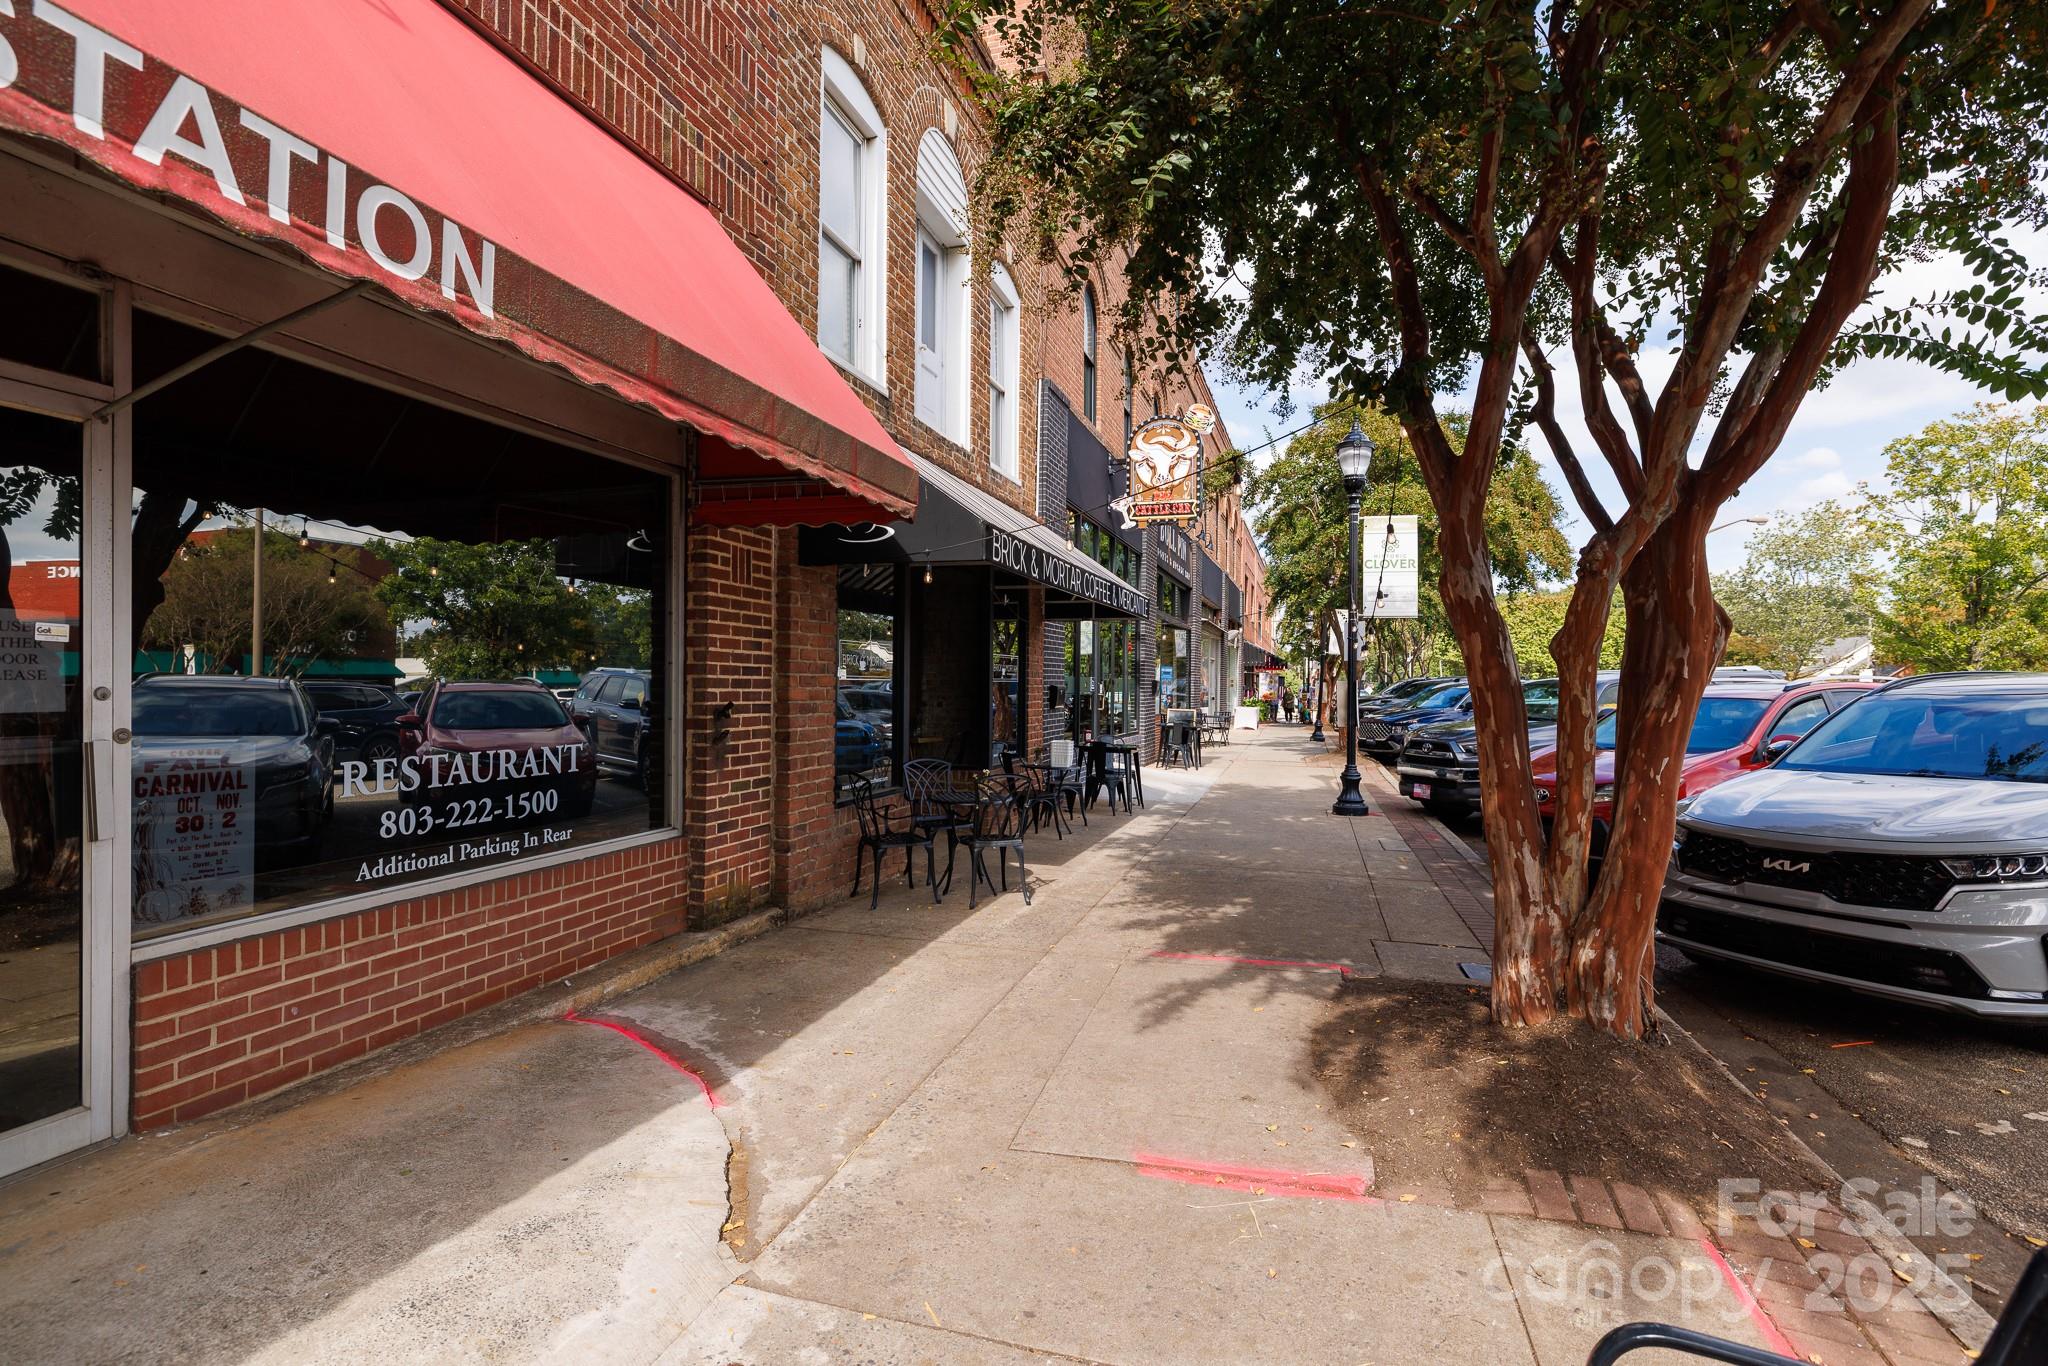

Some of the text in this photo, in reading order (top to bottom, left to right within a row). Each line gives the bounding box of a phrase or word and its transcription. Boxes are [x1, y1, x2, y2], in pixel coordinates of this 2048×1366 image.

[0, 0, 496, 320] TATION
[992, 528, 1148, 618] BRICK & MORTAR COFFEE & MERCANTILE
[1364, 559, 1416, 569] CLOVER
[0, 637, 44, 649] THER
[0, 653, 39, 665] OOR
[143, 753, 243, 773] FALL
[339, 743, 583, 799] RESTAURANT
[134, 770, 248, 799] CARNIVAL
[177, 793, 242, 814] OCT. NOV.
[379, 789, 558, 839] 803-222-1500
[175, 815, 204, 834] 30
[222, 812, 236, 829] 2
[355, 828, 573, 882] Additional Parking In Rear
[1763, 857, 1810, 873] KIA
